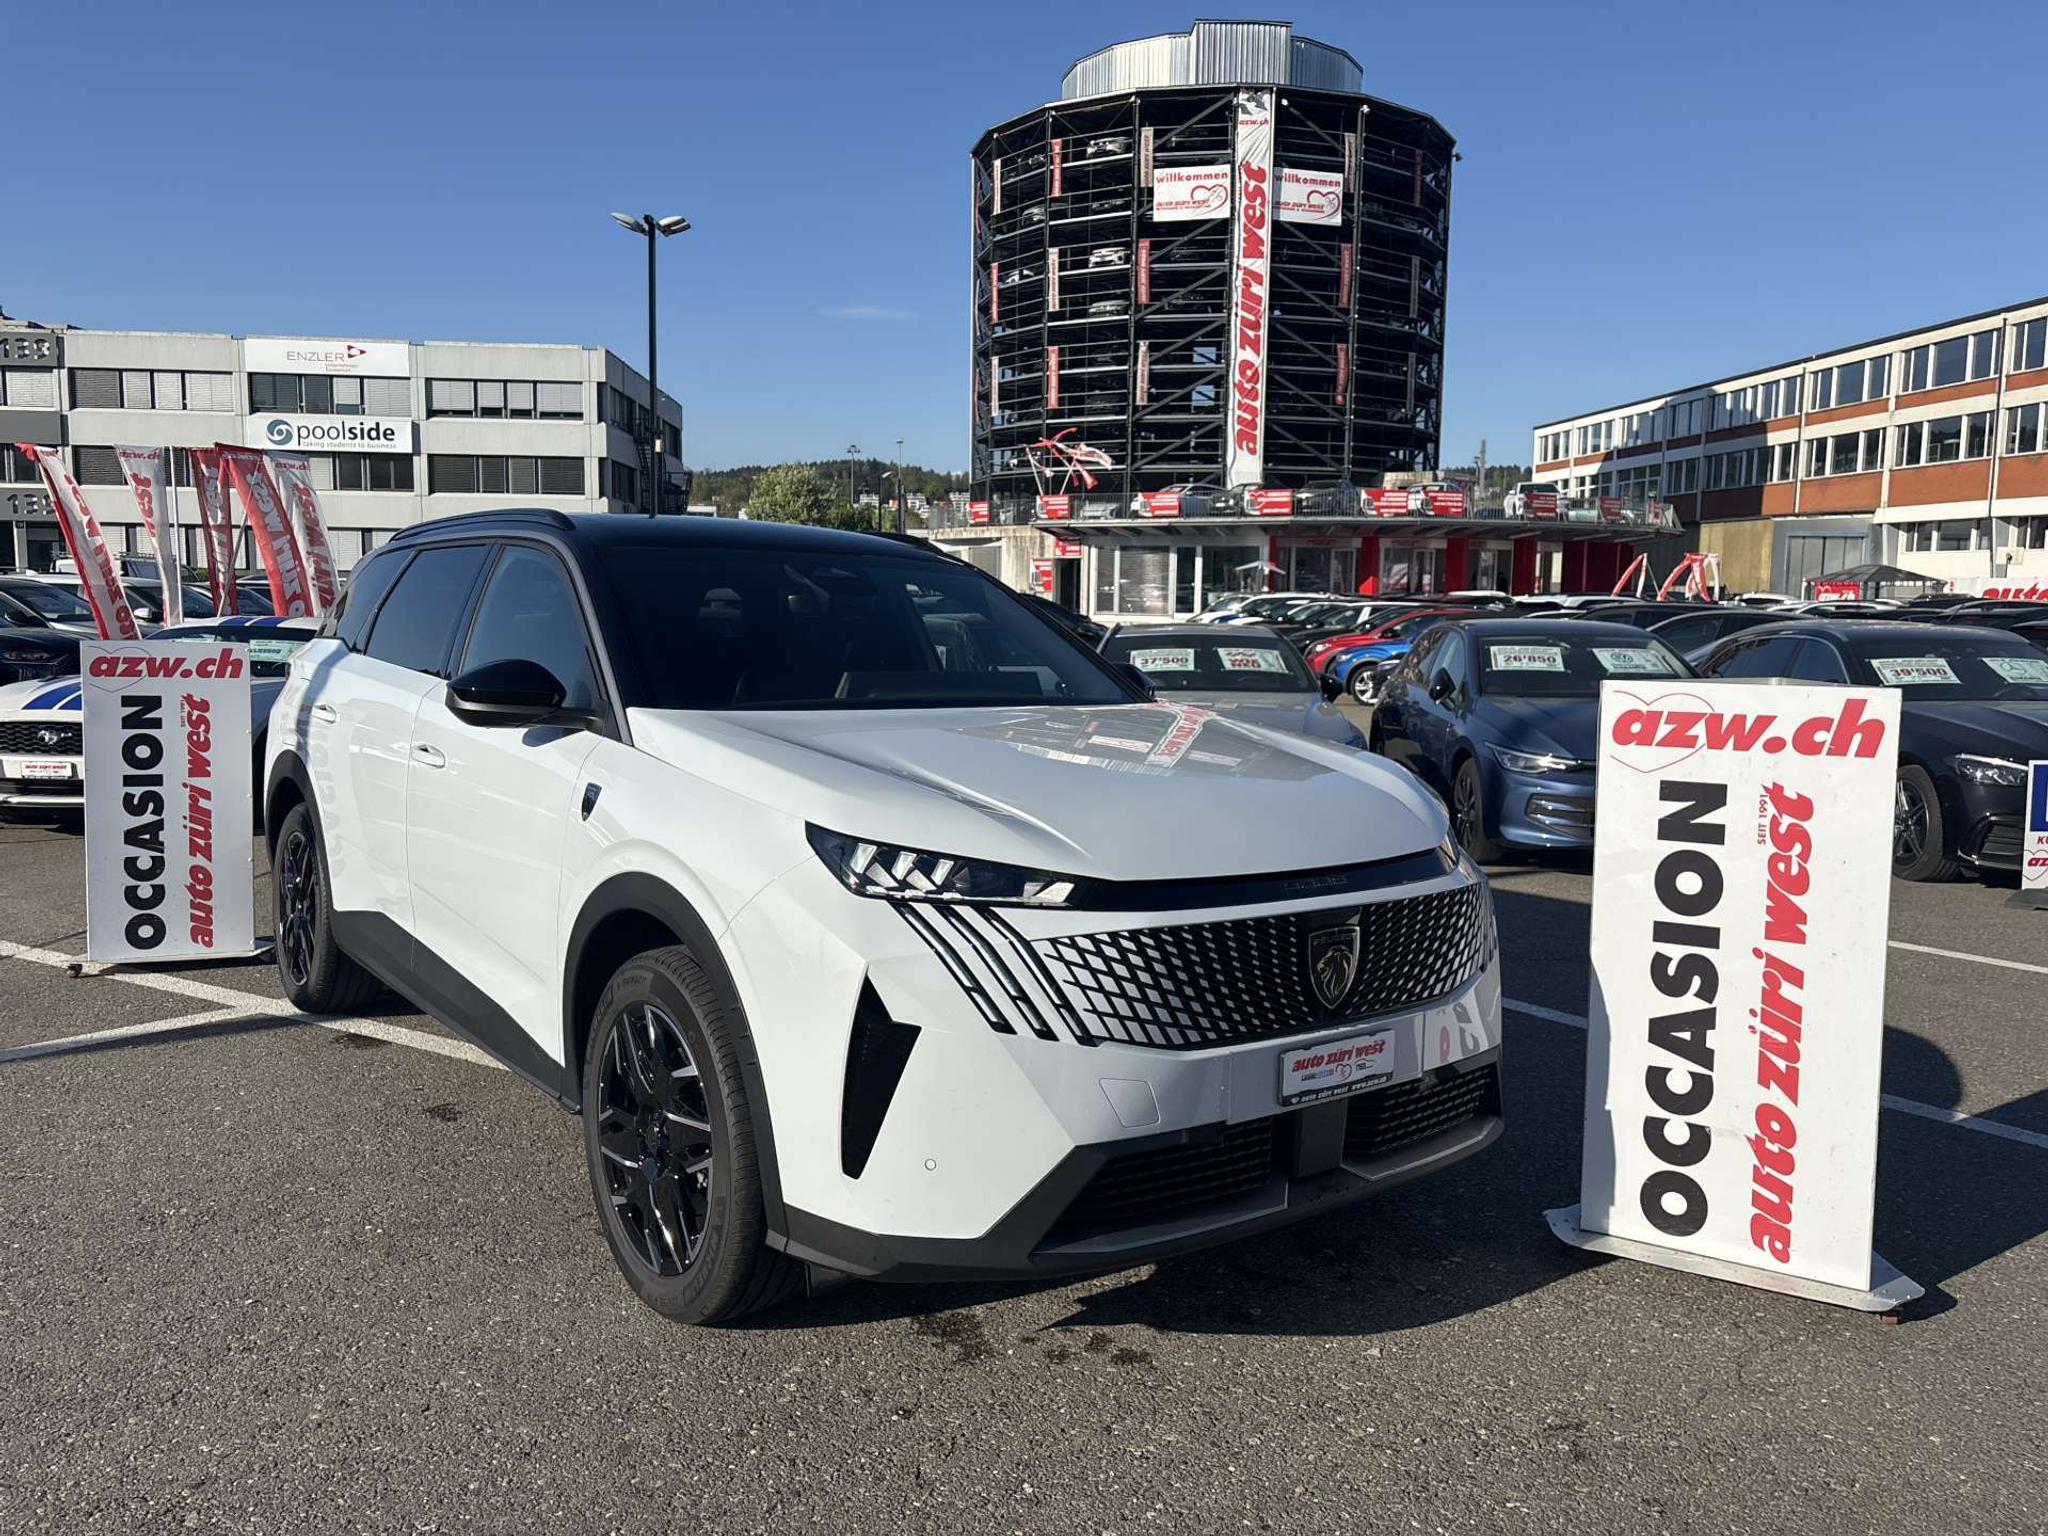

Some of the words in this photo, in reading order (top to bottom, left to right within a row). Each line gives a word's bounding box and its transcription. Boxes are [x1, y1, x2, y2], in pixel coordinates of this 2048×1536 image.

[1238, 118, 1270, 126] azw.ch
[1156, 172, 1229, 184] willkommen
[1274, 173, 1341, 188] willkommen
[1241, 160, 1267, 259] west
[1234, 265, 1264, 357] züri
[287, 351, 345, 362] ENZLER
[1235, 358, 1261, 456] auto
[297, 421, 396, 446] poolside
[303, 441, 325, 449] taking
[327, 441, 357, 449] students
[88, 648, 244, 680] azw.ch
[1140, 657, 1189, 665] 37'500
[1503, 654, 1557, 664] 26'850
[182, 692, 212, 778] west
[1611, 698, 1885, 759] azw.ch
[120, 695, 167, 950] OCCASION
[182, 781, 213, 864] züri
[1758, 794, 1769, 819] 1991
[1757, 822, 1766, 845] SEIT
[1761, 781, 1814, 944] west
[184, 862, 214, 949] auto
[1639, 779, 1728, 1237] OCCASION
[1747, 947, 1804, 1108] züri
[1291, 1054, 1323, 1073] auto
[1325, 1045, 1355, 1066] züri
[1355, 1040, 1386, 1059] west
[1745, 1102, 1797, 1264] auto
